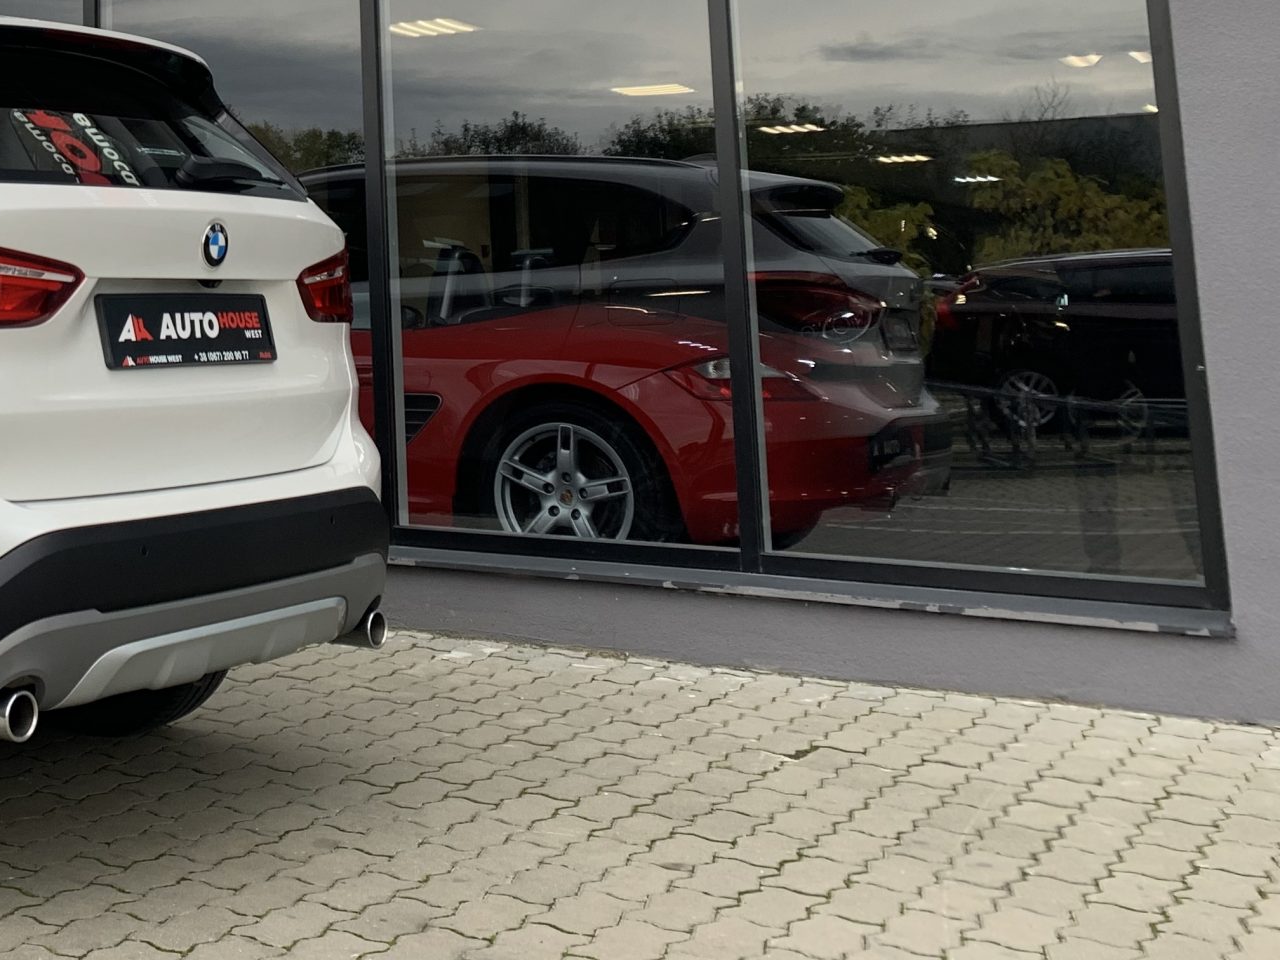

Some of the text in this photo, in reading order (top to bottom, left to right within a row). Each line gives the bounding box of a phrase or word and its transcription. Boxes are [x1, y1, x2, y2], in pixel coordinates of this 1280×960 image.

[160, 311, 220, 340] AUTO
[220, 311, 261, 328] HOUSE
[245, 329, 262, 339] WEST
